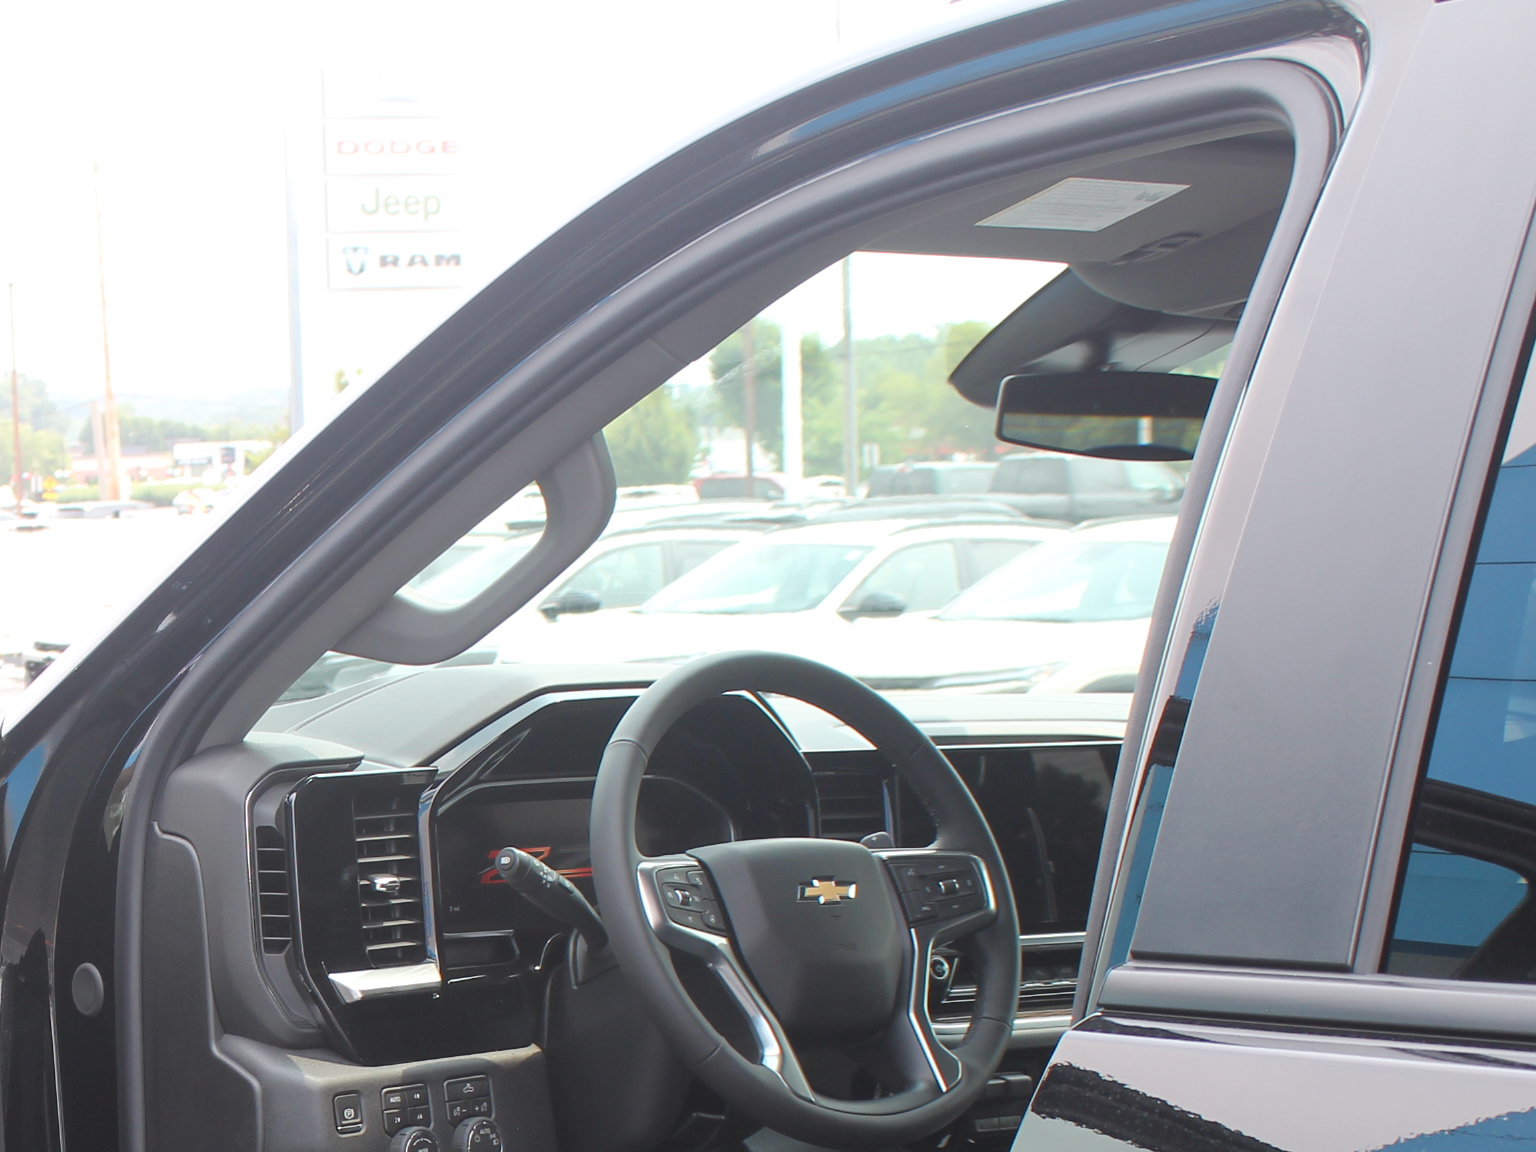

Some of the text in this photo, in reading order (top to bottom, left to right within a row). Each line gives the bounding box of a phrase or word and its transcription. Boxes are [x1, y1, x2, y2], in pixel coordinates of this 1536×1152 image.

[337, 140, 458, 155] DODGE
[361, 187, 441, 222] Jeep
[378, 253, 462, 268] RAM
